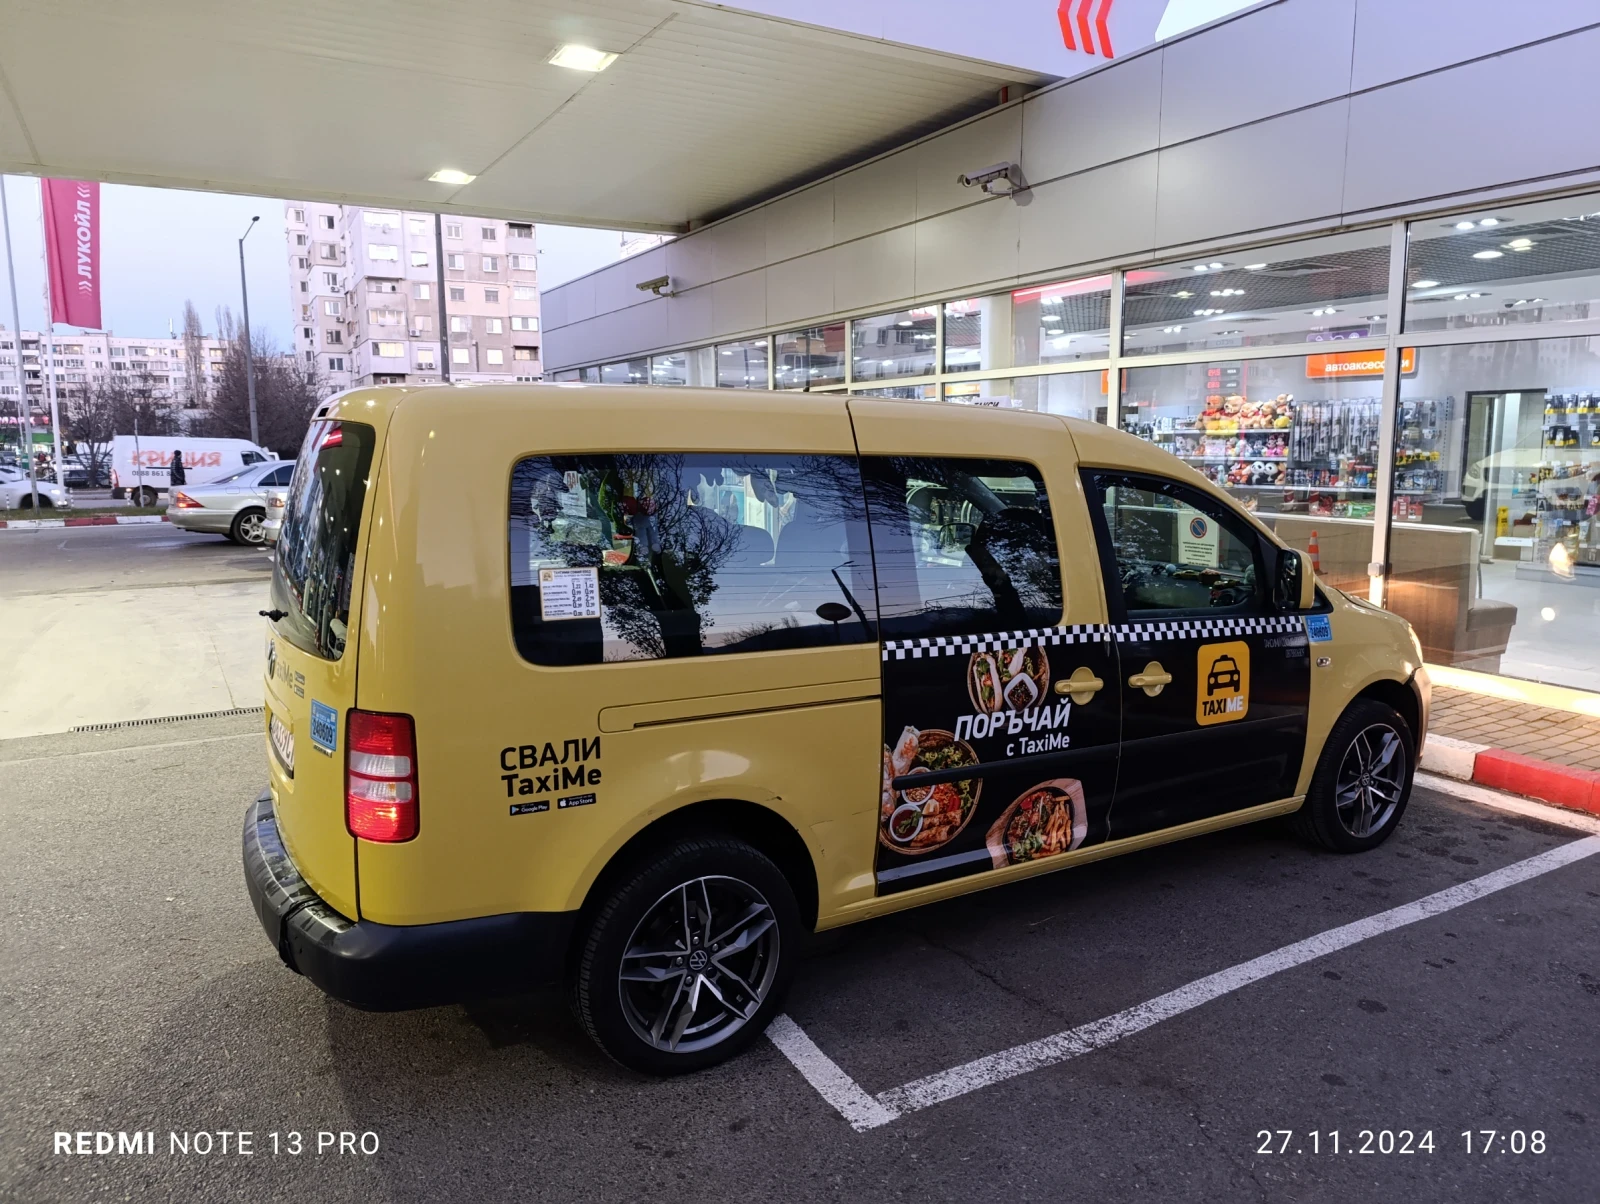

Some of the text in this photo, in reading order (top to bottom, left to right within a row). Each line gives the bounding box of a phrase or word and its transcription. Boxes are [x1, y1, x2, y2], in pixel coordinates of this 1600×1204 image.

[74, 200, 92, 279] ЛУКОЙЛ
[953, 697, 1071, 742] ПОРЪЧАЙ
[1202, 695, 1244, 717] TAXIME
[500, 736, 601, 771] СВАЛИ
[1019, 732, 1070, 755] TaxiMe
[501, 764, 602, 798] TaxiMe
[521, 805, 538, 813] Google
